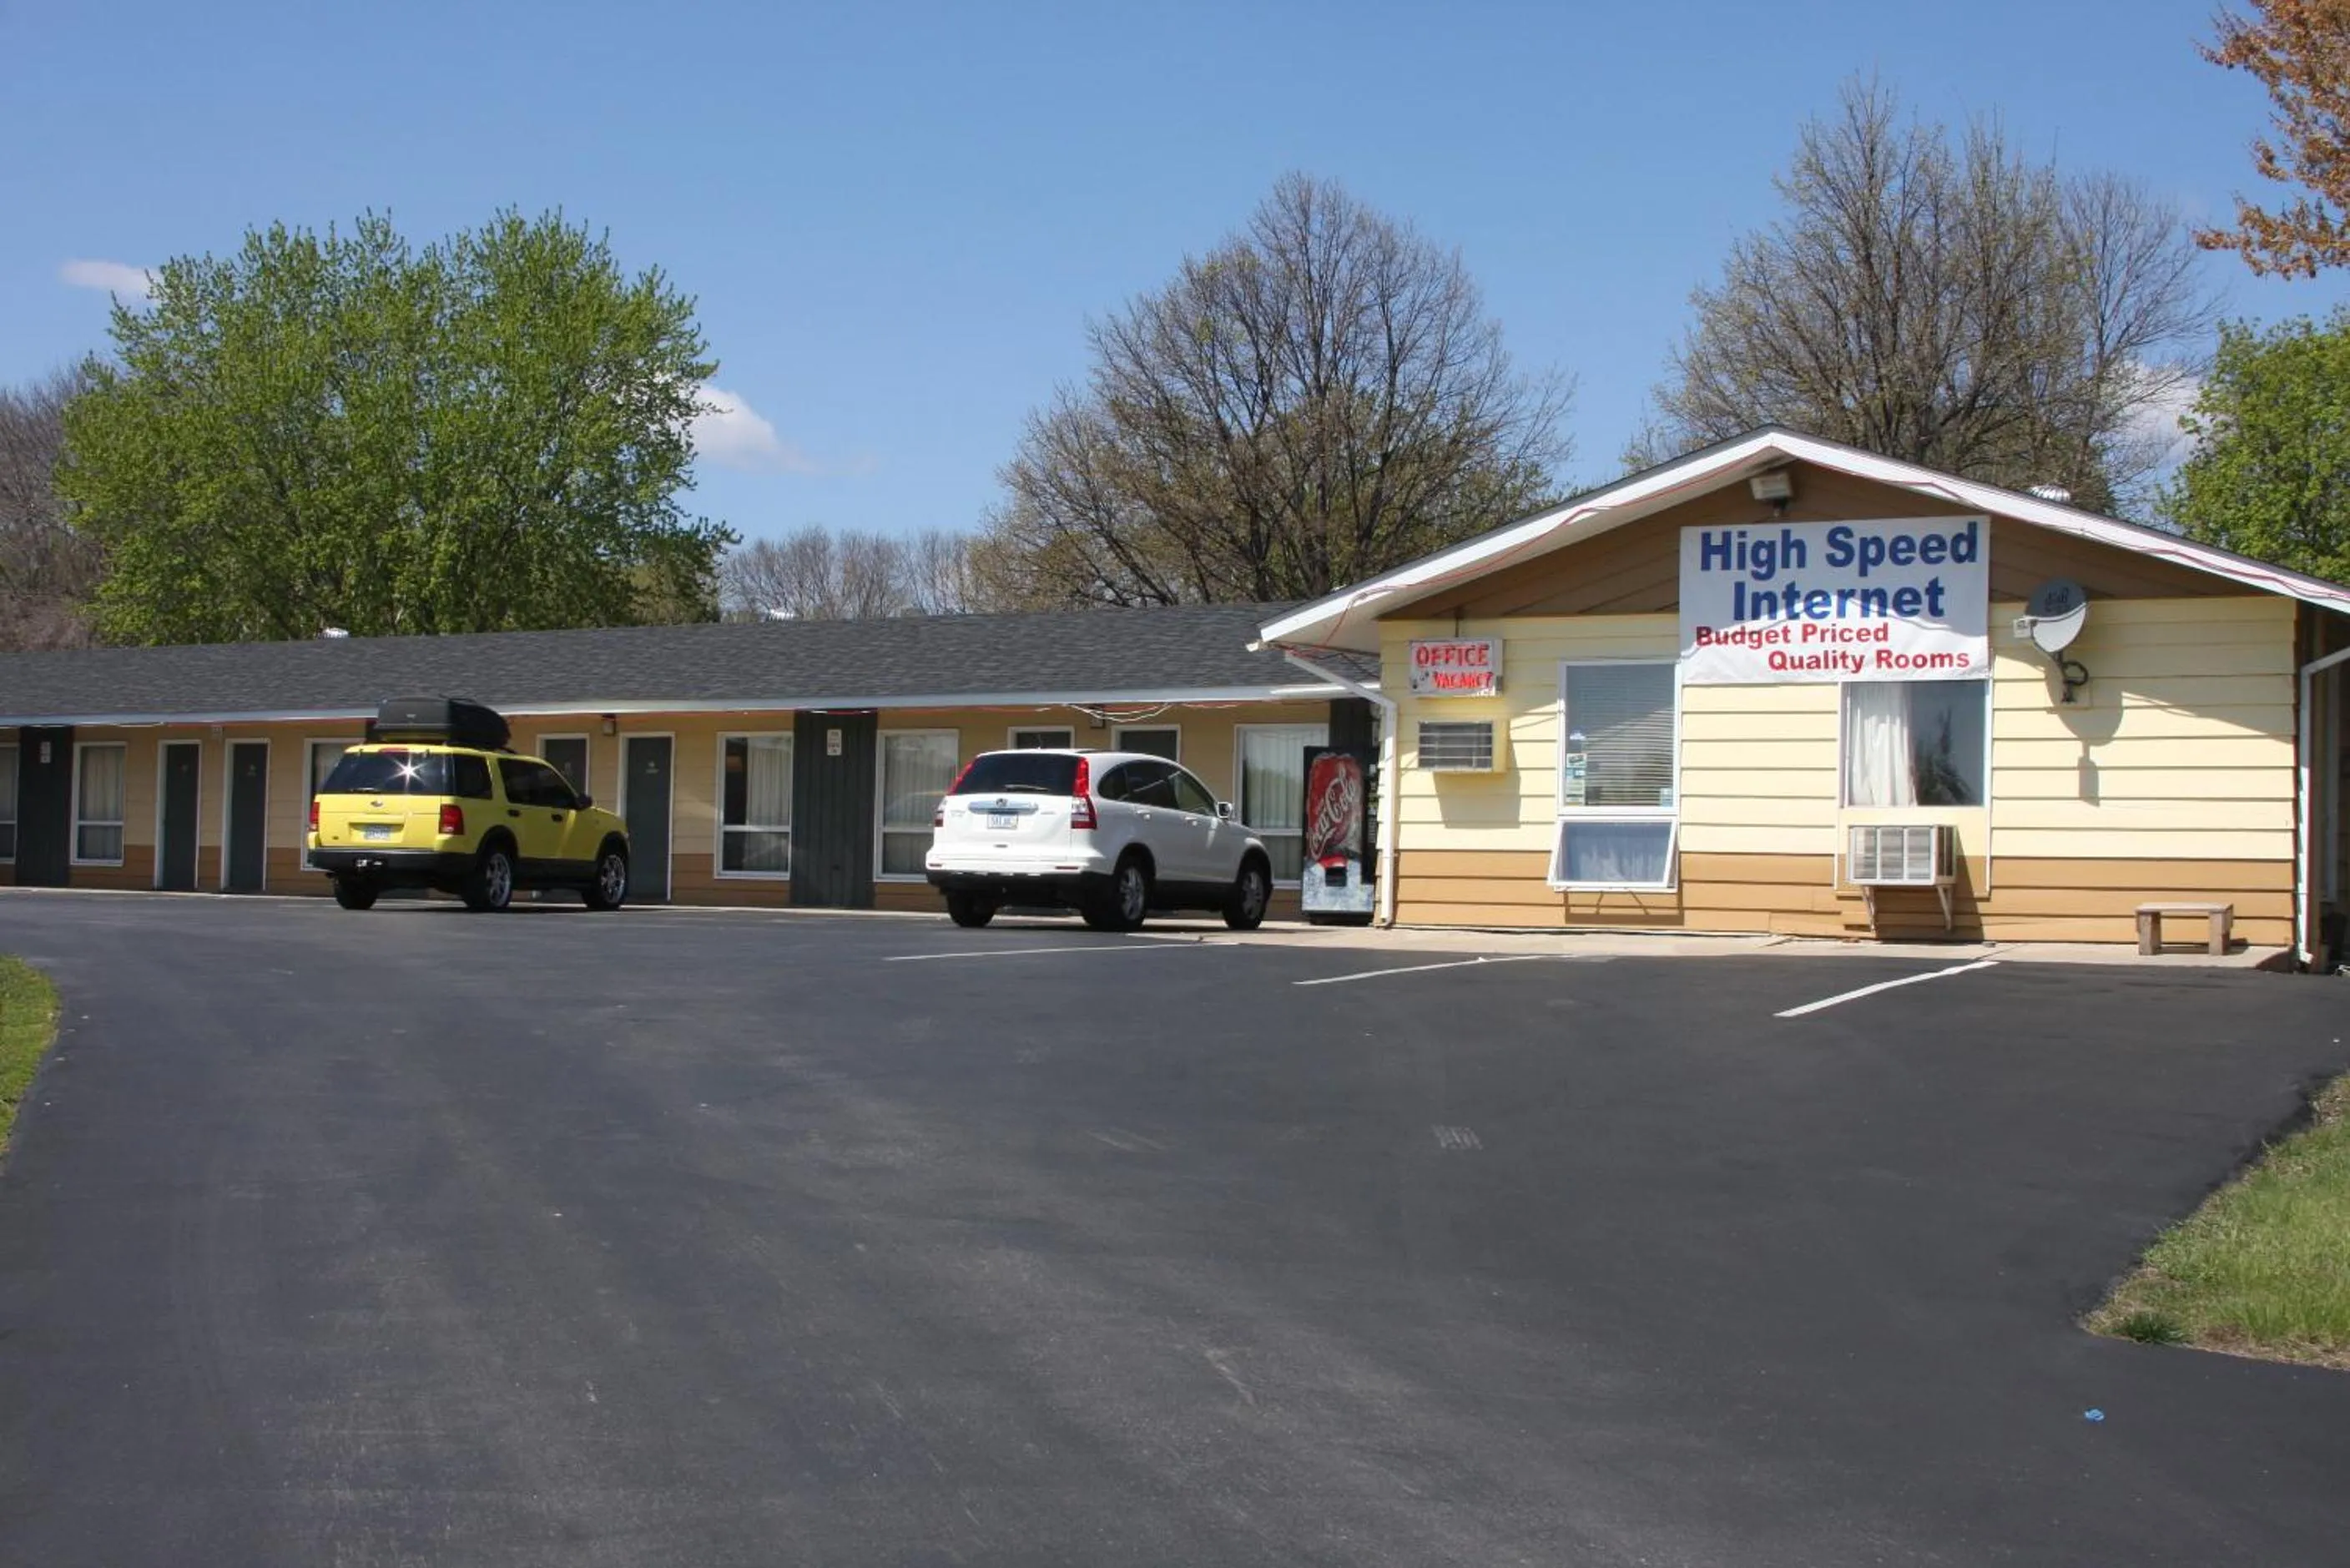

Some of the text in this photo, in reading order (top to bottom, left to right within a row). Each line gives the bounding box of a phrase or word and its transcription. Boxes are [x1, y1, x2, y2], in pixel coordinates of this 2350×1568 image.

[1700, 521, 1977, 580] High Speed
[1733, 577, 1945, 621] Internet
[1696, 623, 1889, 649] Budget Priced
[1416, 643, 1490, 667] OFFICE
[1768, 650, 1970, 674] Quality Rooms
